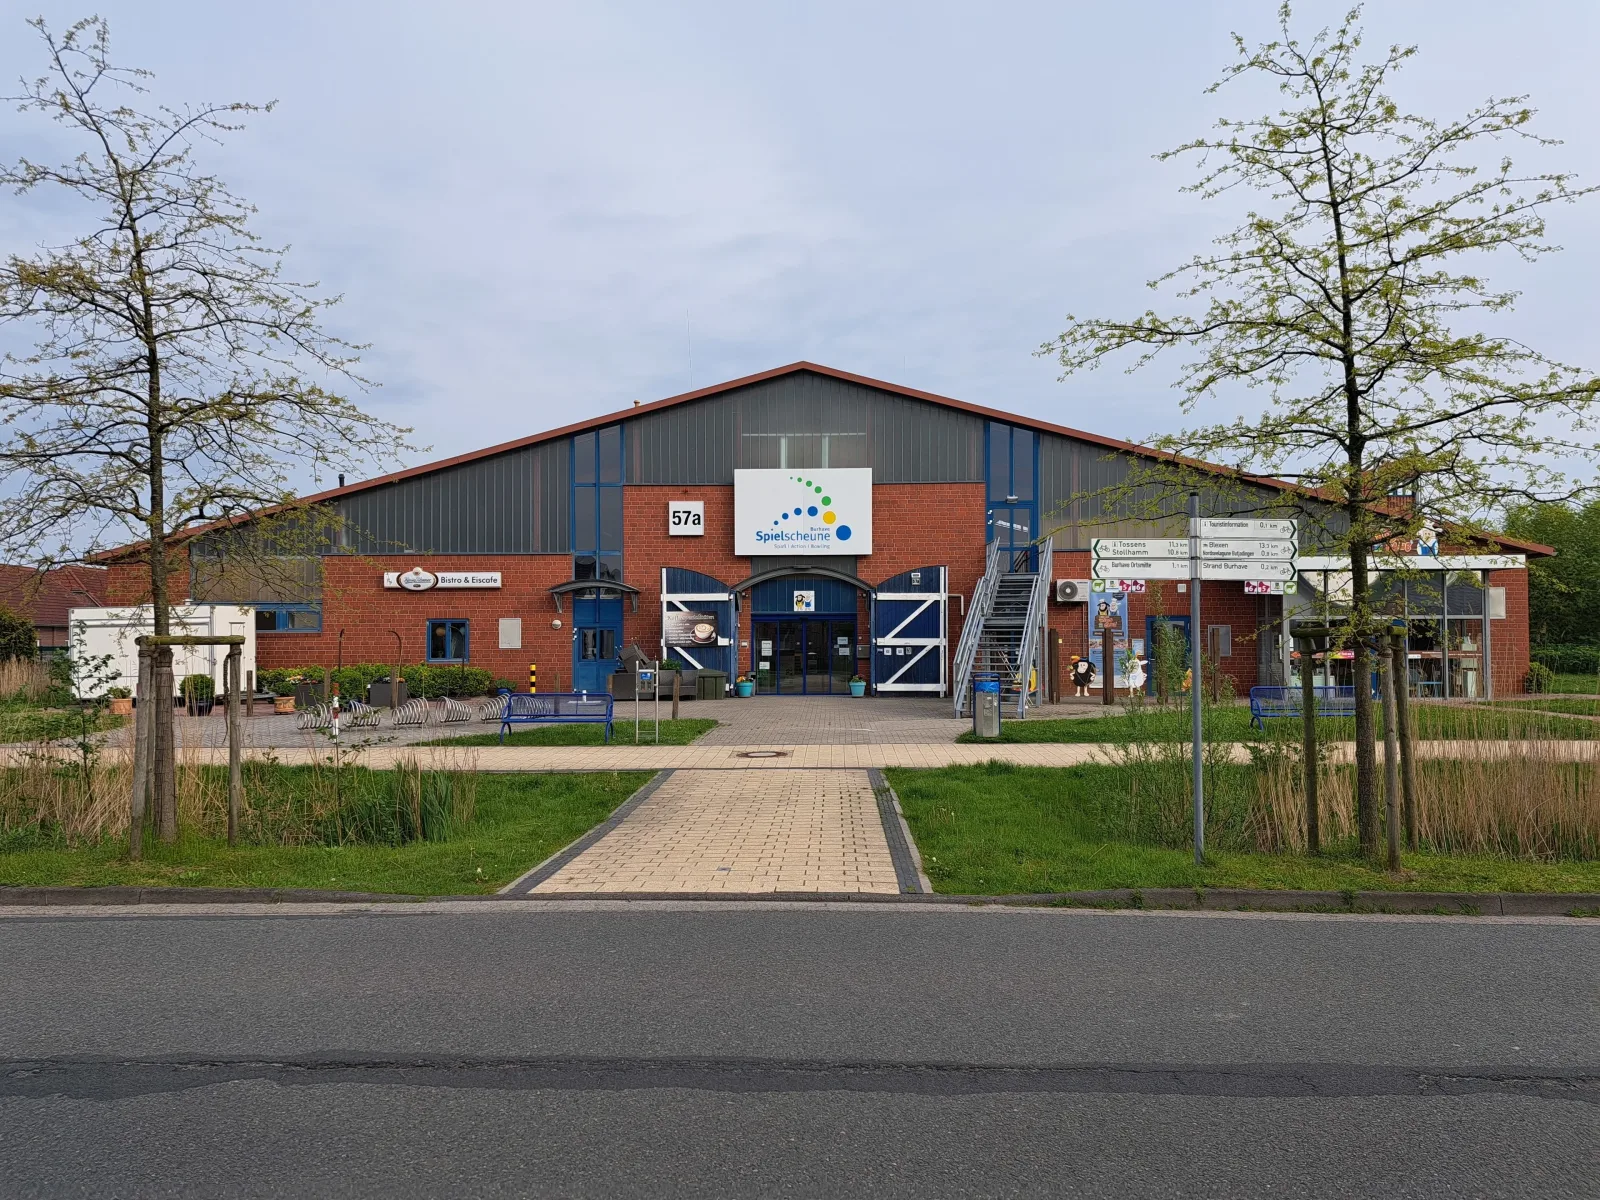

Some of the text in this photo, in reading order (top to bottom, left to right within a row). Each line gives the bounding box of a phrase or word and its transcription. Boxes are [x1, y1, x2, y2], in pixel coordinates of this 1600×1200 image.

[672, 510, 701, 526] 57a
[756, 529, 831, 544] Spielscheune
[441, 576, 498, 584] Bistro & Eiscafe
